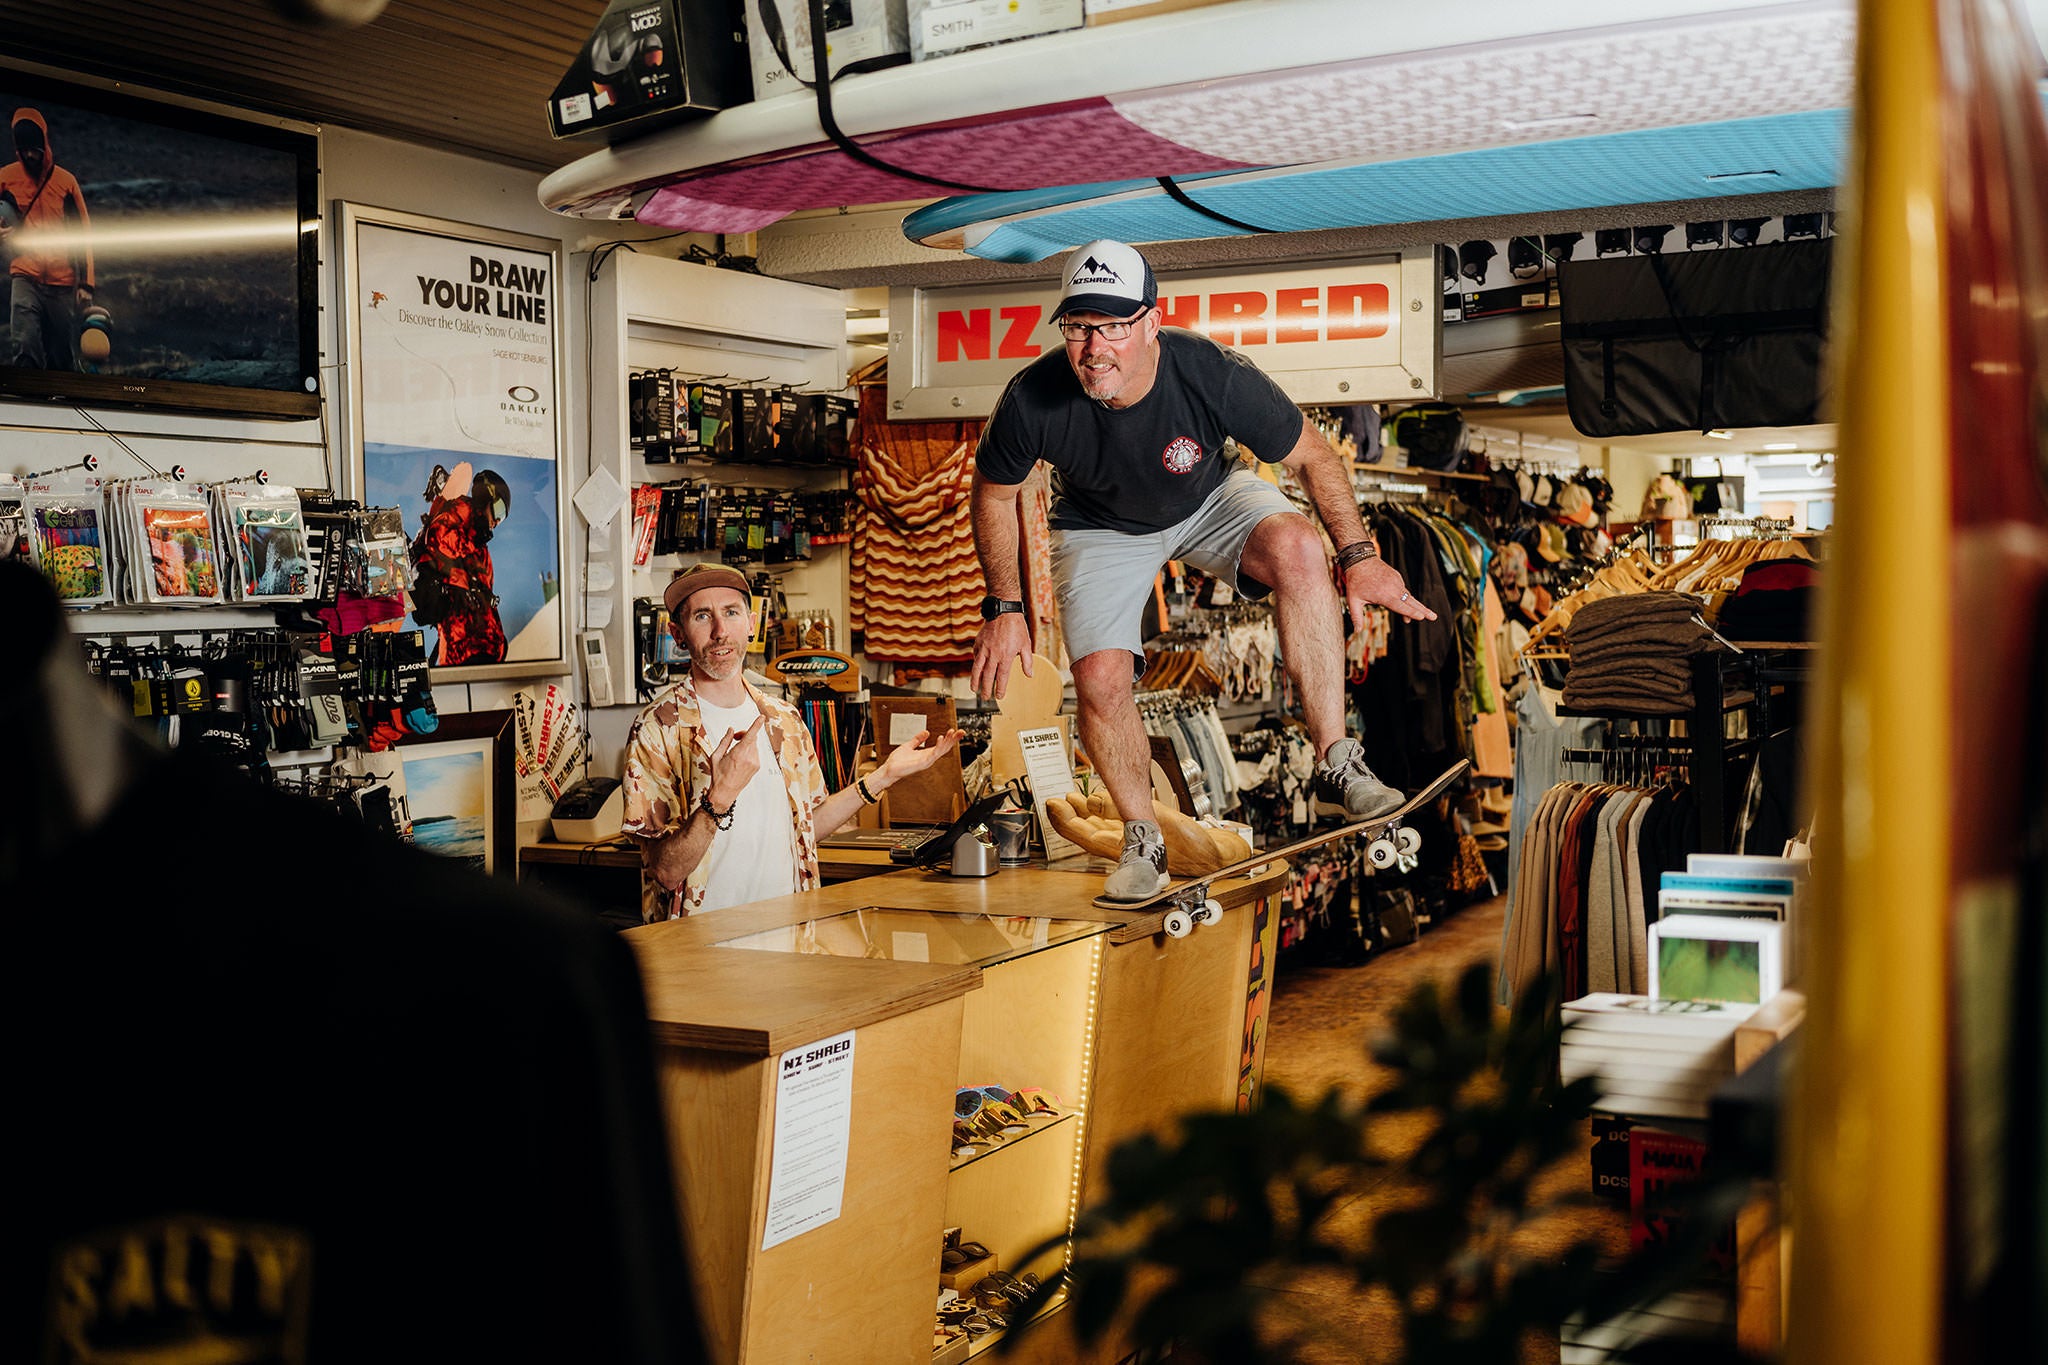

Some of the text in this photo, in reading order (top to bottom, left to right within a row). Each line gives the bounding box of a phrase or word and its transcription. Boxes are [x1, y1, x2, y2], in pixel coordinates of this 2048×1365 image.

[931, 19, 974, 38] SMITH
[470, 255, 547, 295] DRAW
[1073, 277, 1116, 285] NZSHRED
[416, 275, 546, 325] YOUR LINE
[399, 308, 548, 345] Discover the Oakley Snow Collection
[937, 283, 1390, 363] NZ HRED
[123, 385, 146, 393] SONY
[501, 402, 547, 415] OAKLEY
[300, 665, 337, 674] DAKINE
[398, 661, 429, 672] DAKINE
[537, 684, 558, 765] NZSHRED
[1034, 732, 1060, 743] SHRED
[784, 1040, 850, 1071] NZ SHRED
